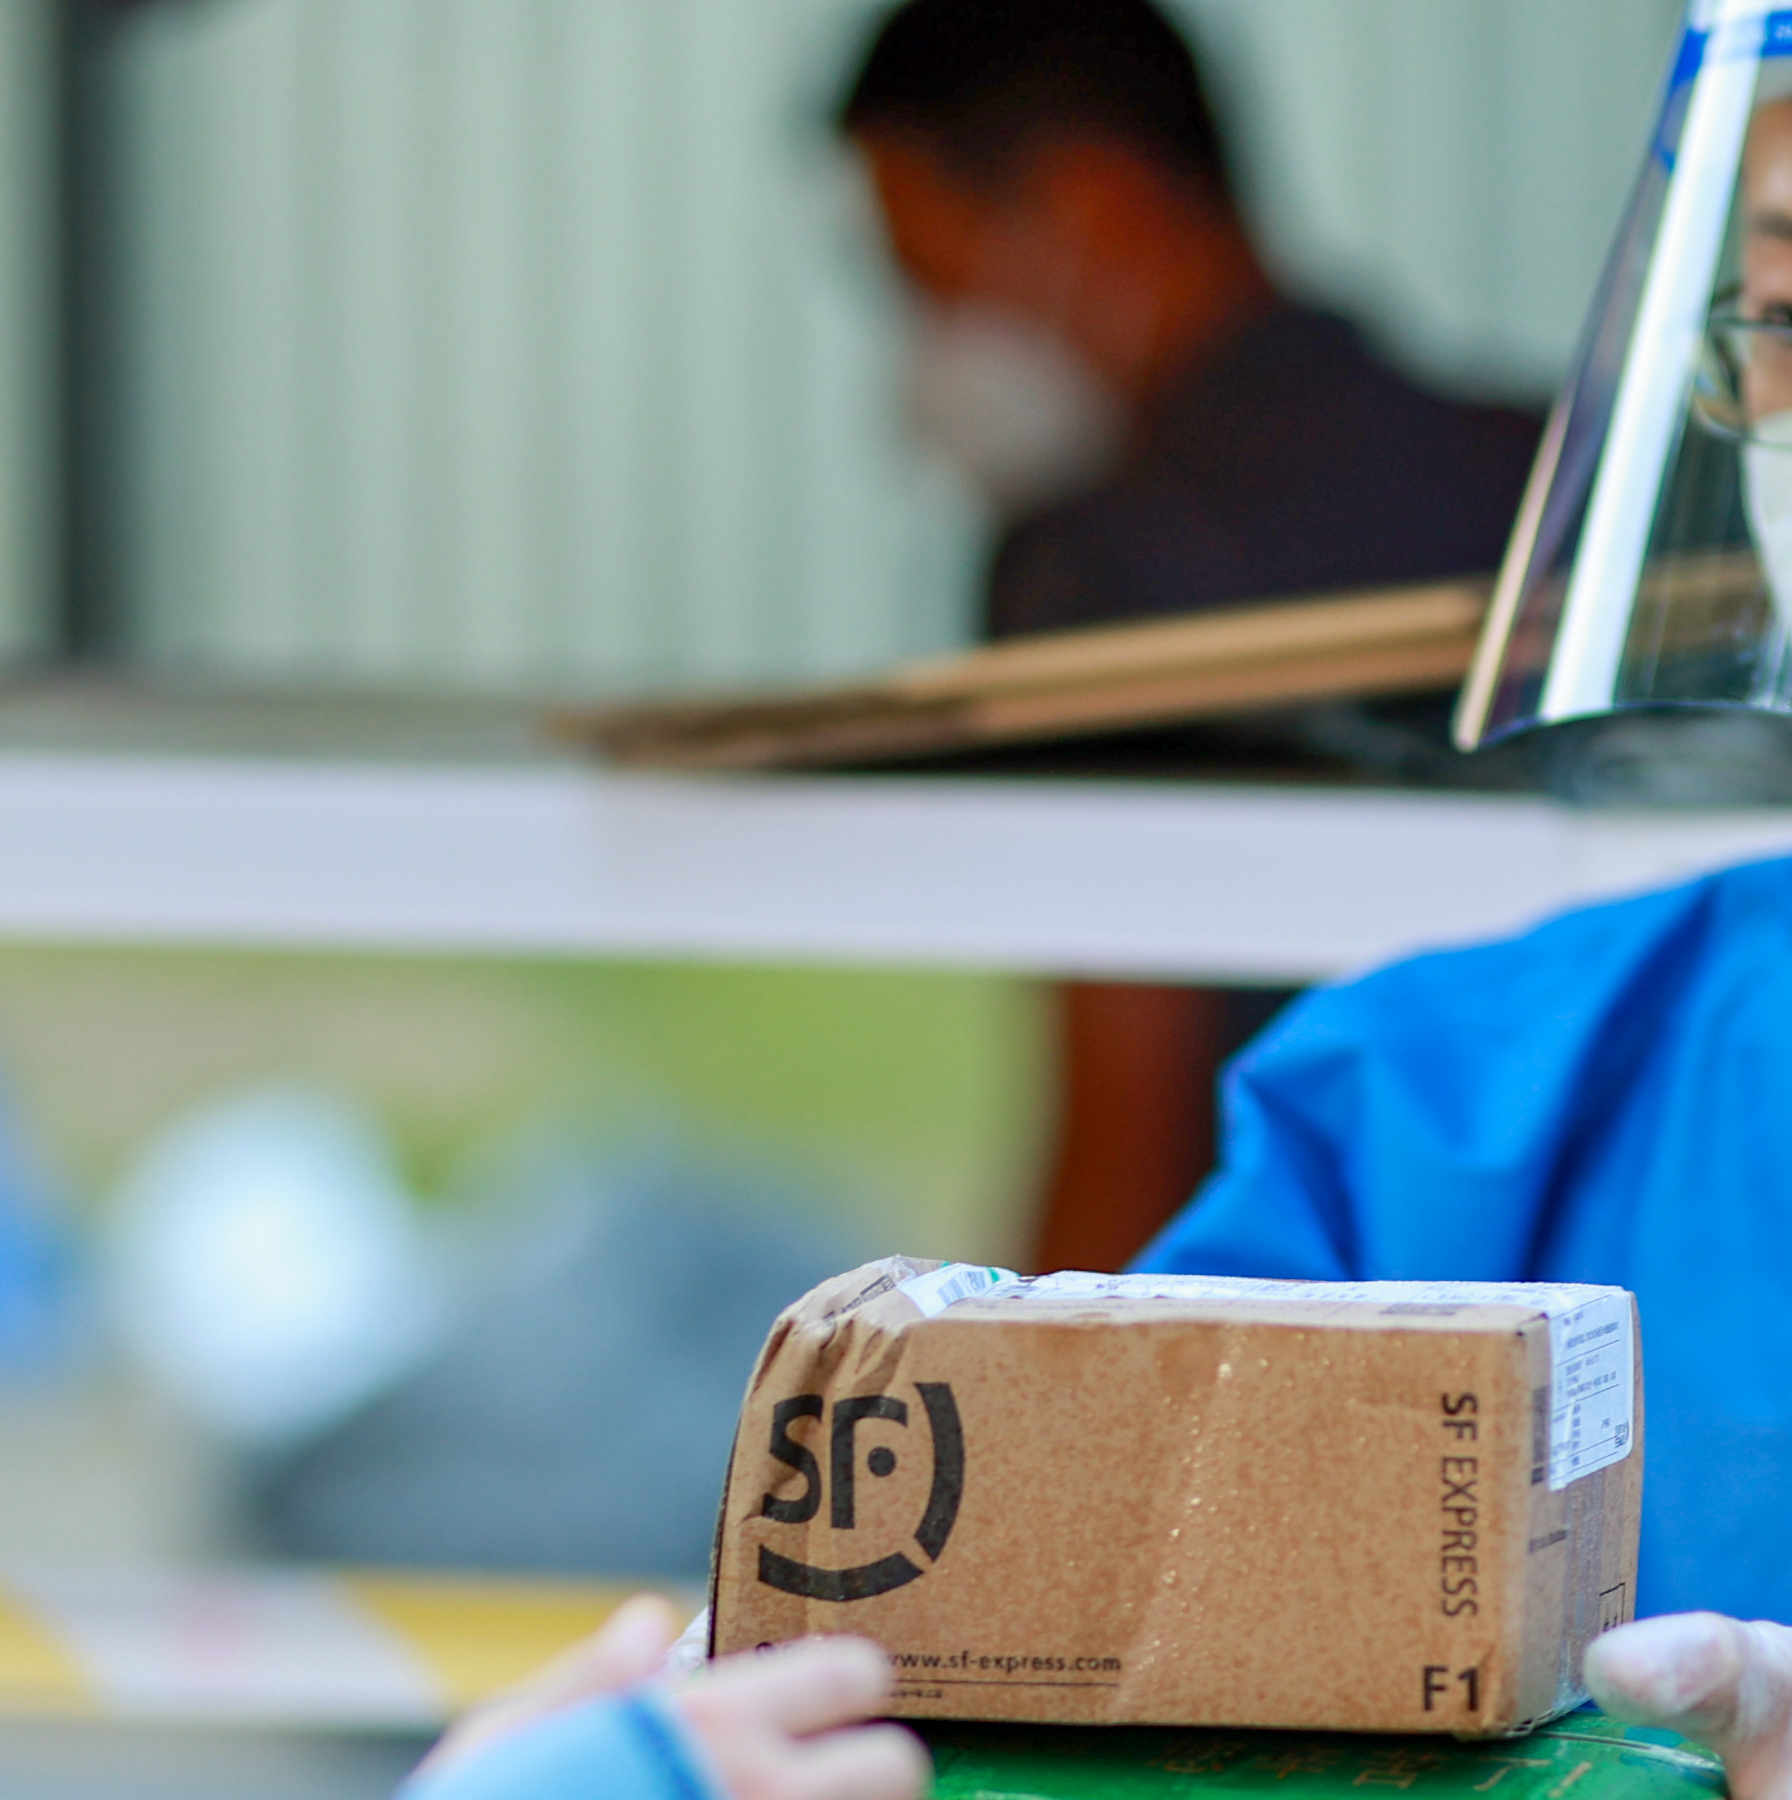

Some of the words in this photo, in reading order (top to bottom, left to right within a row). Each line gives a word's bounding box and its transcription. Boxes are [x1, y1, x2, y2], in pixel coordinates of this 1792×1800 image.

[1441, 1392, 1479, 1441] SF
[1441, 1456, 1479, 1617] EXPRESS
[1421, 1664, 1480, 1713] F1
